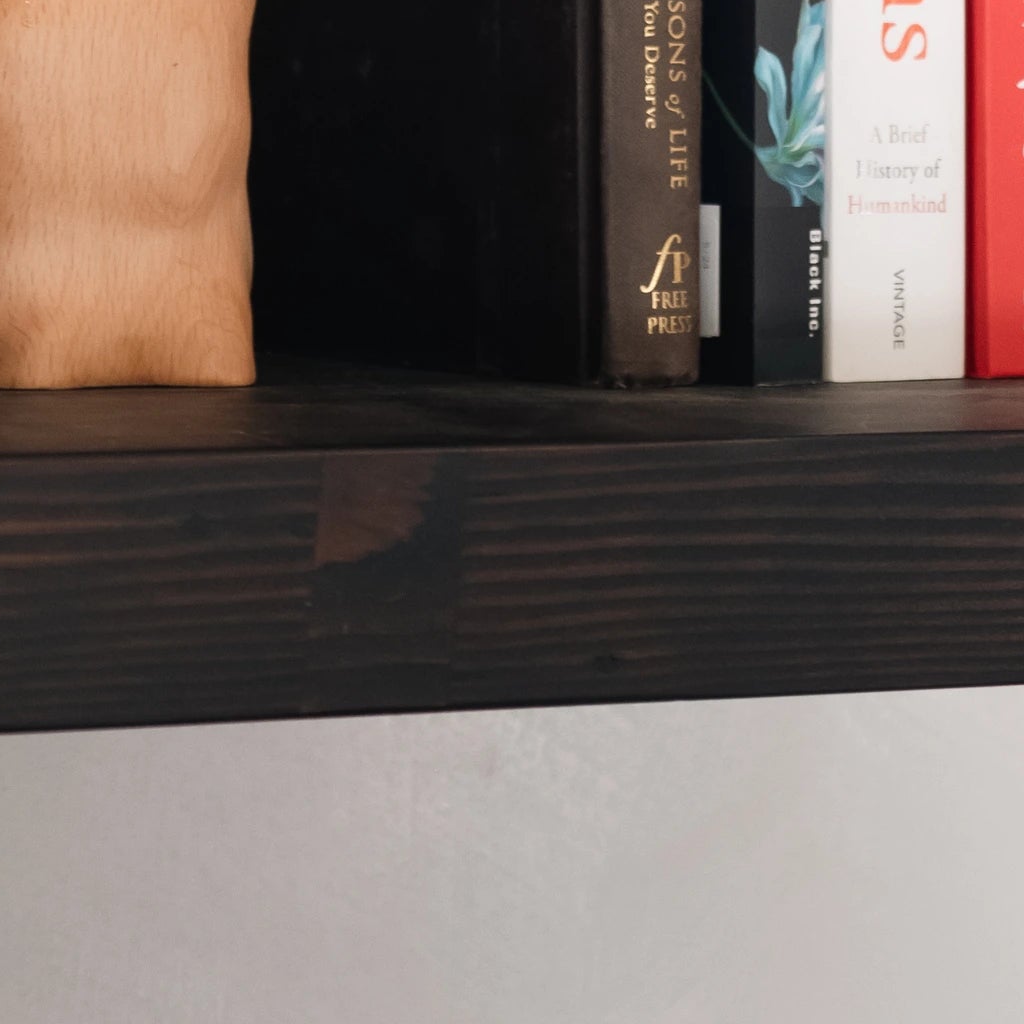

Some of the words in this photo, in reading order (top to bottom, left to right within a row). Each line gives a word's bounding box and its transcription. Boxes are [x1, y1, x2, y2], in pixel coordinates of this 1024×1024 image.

[642, 0, 660, 38] You
[643, 46, 661, 130] Deserve
[664, 93, 686, 121] of
[871, 124, 883, 144] A
[888, 123, 931, 144] Brief
[668, 128, 689, 190] LIFE
[924, 156, 942, 179] of
[808, 229, 822, 291] Black
[651, 290, 689, 310] FREE
[808, 298, 822, 338] Inc.
[892, 269, 906, 351] VINTAGE
[647, 315, 693, 335] PRESS
